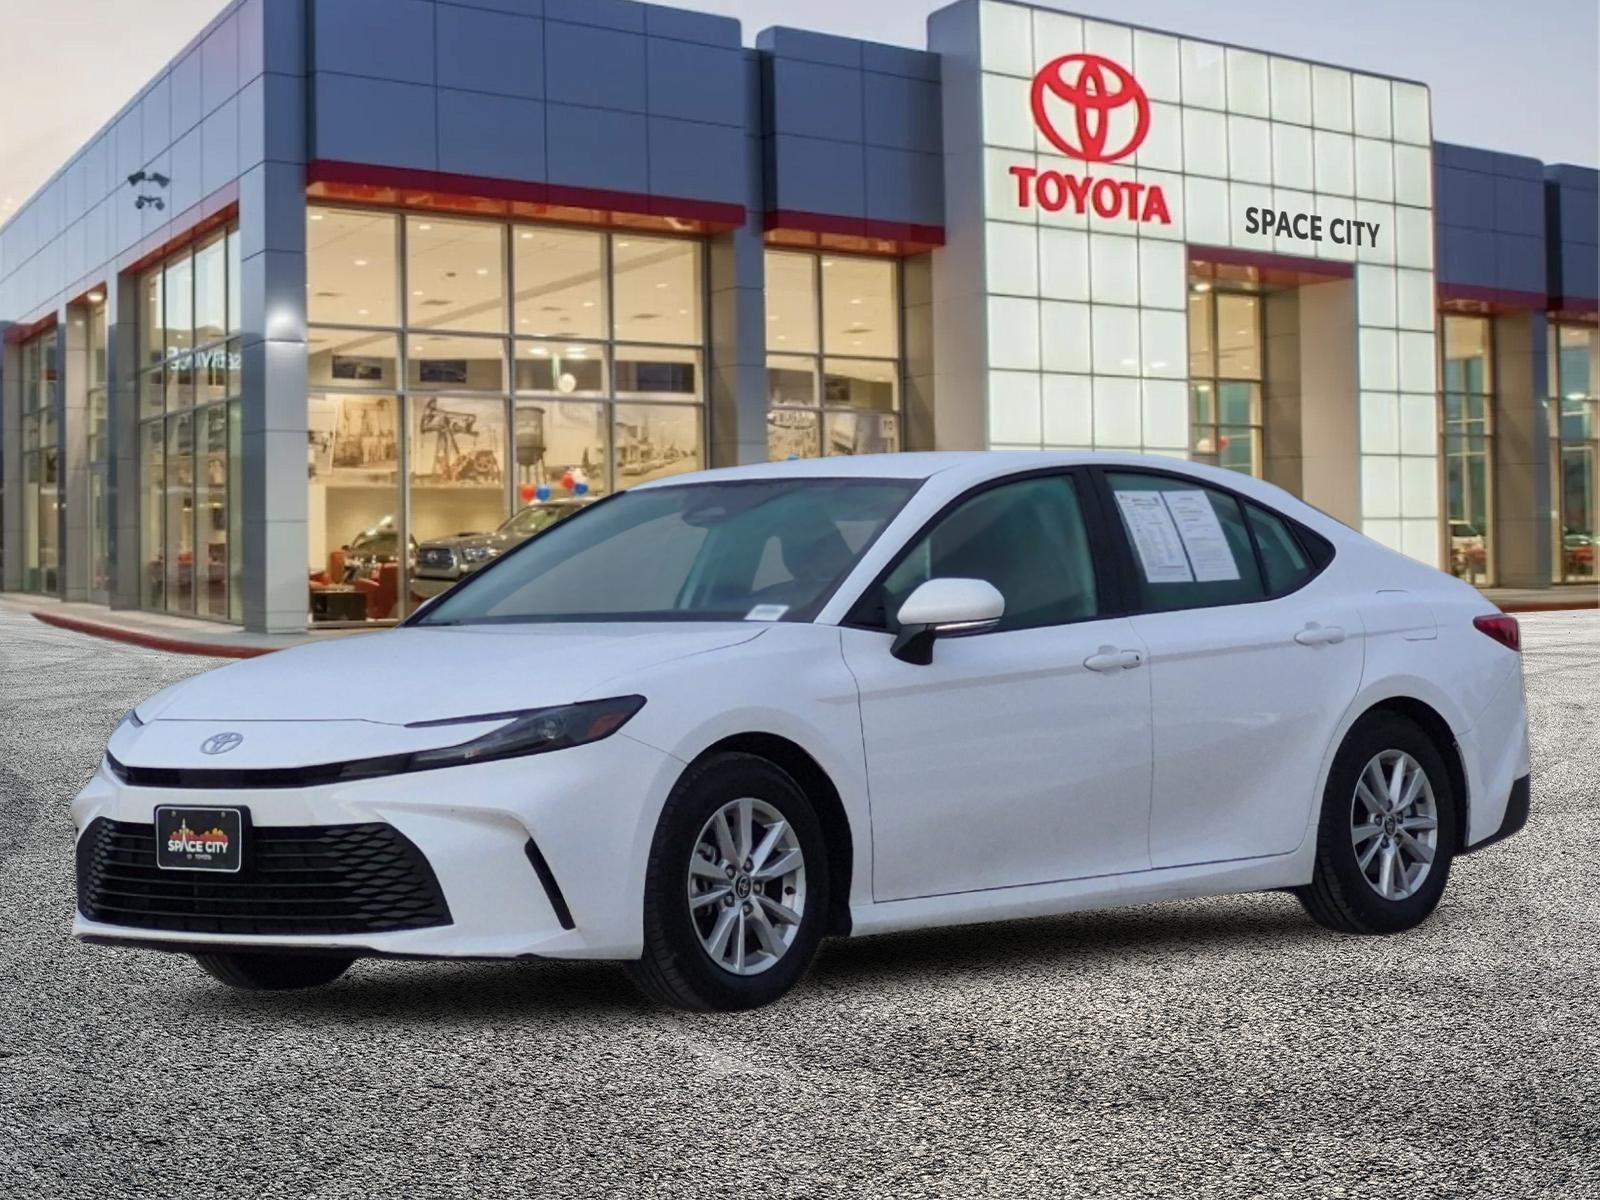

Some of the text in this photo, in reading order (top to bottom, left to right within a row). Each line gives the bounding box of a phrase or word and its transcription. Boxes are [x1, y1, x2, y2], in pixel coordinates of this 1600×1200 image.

[1009, 166, 1171, 225] TOYOTA
[1245, 206, 1380, 248] SPACE CITY
[168, 840, 228, 853] SPACE CITY
